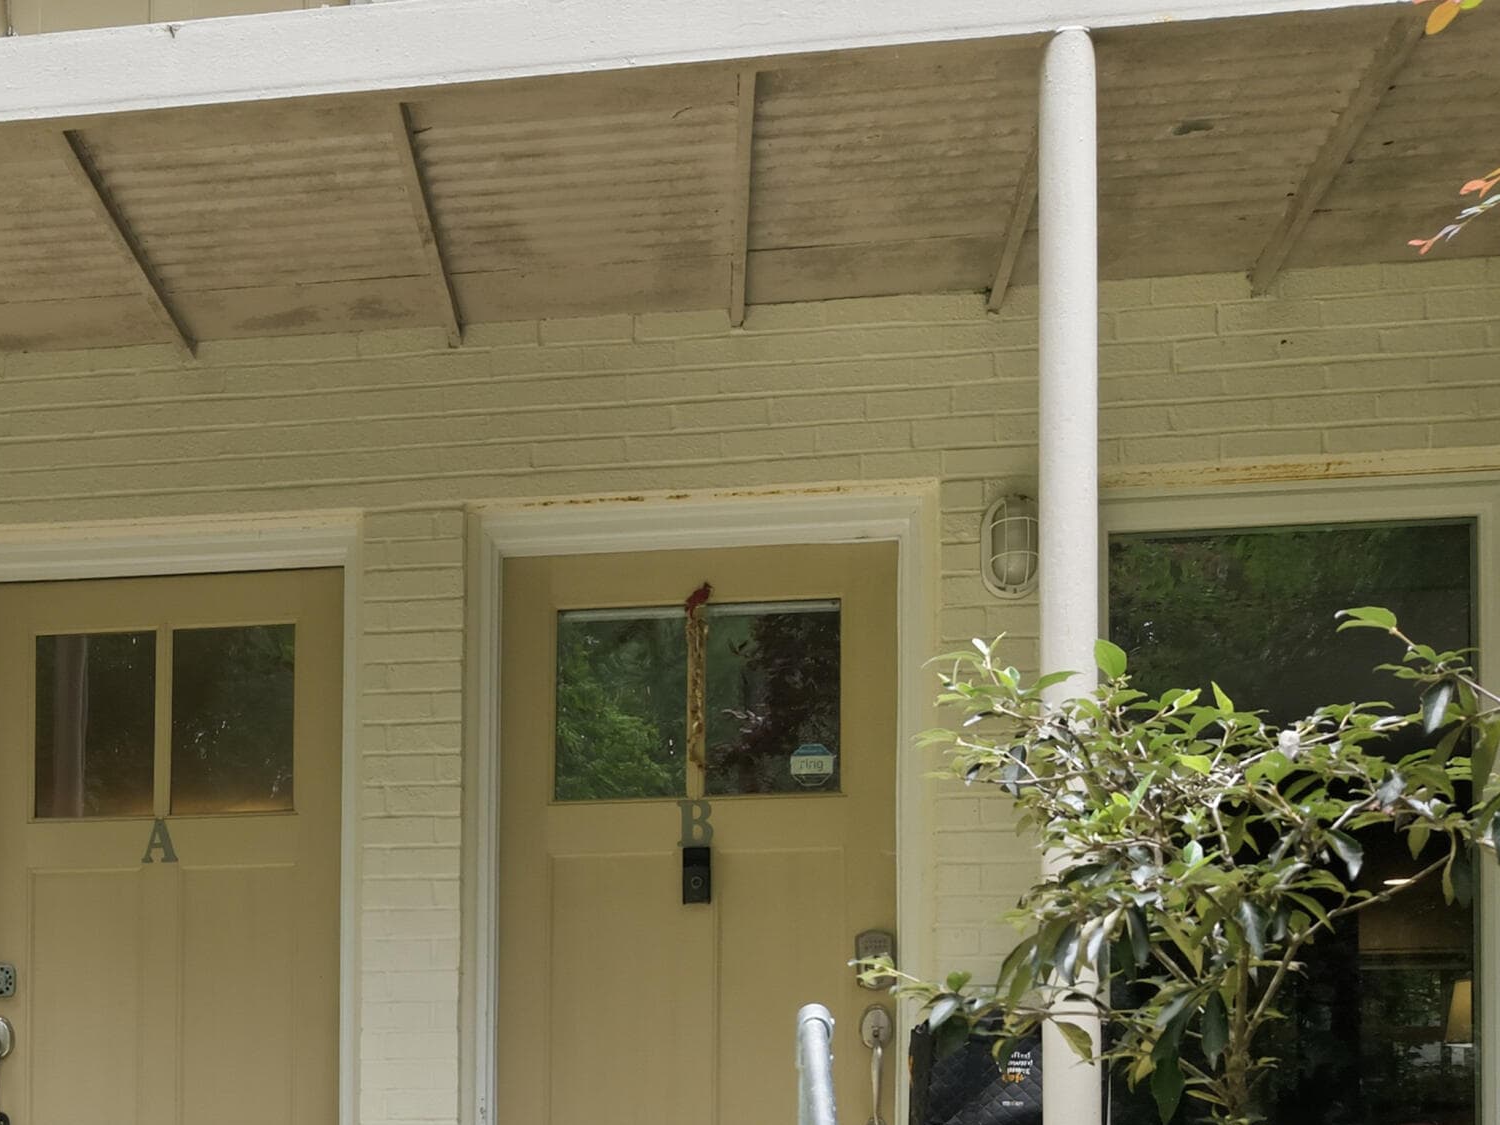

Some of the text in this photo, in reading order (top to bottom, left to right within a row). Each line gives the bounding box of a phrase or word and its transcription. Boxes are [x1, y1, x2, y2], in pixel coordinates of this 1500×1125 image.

[799, 759, 824, 772] ring
[141, 818, 179, 863] A
[677, 800, 713, 847] B
